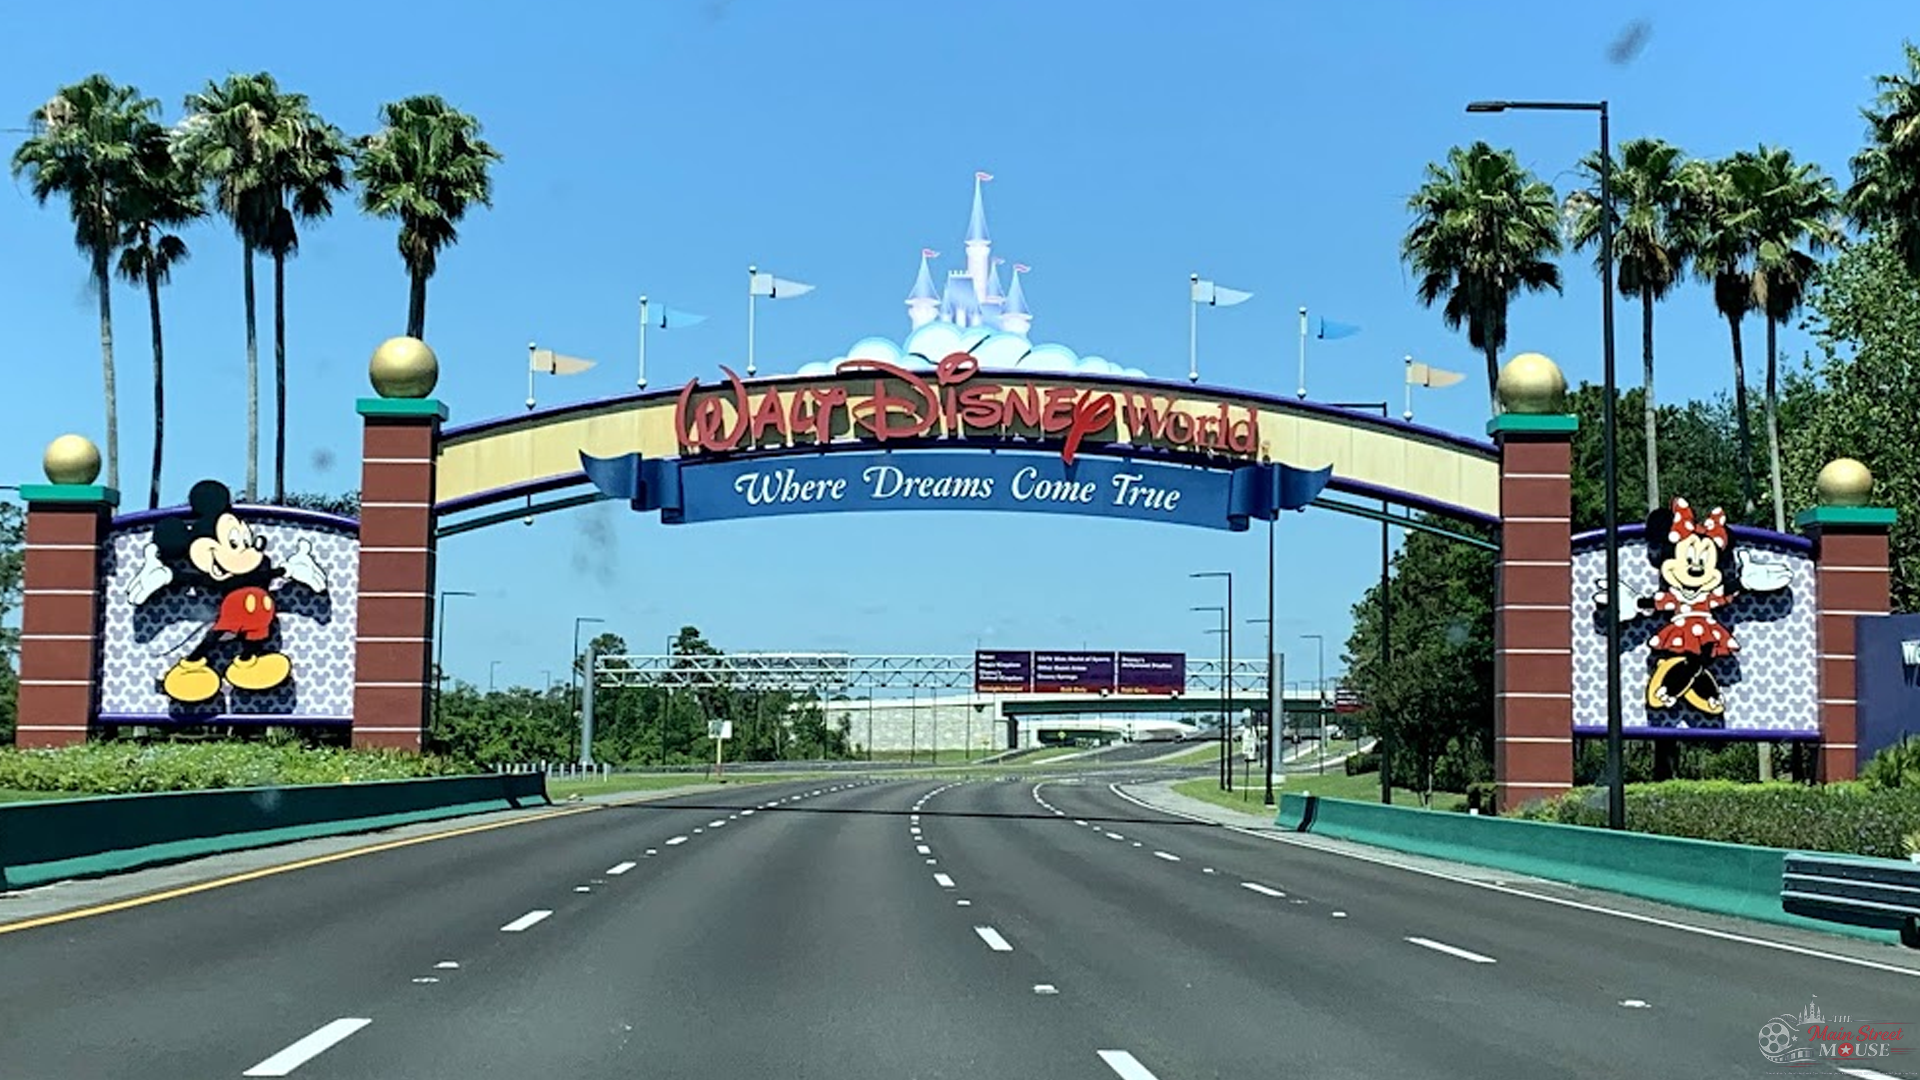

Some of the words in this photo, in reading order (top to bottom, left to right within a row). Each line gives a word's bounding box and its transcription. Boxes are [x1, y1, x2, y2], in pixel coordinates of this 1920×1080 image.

[1121, 389, 1260, 455] World
[734, 468, 847, 505] Where
[863, 465, 995, 499] Dreams
[1011, 465, 1096, 502] Come
[1111, 473, 1181, 511] True
